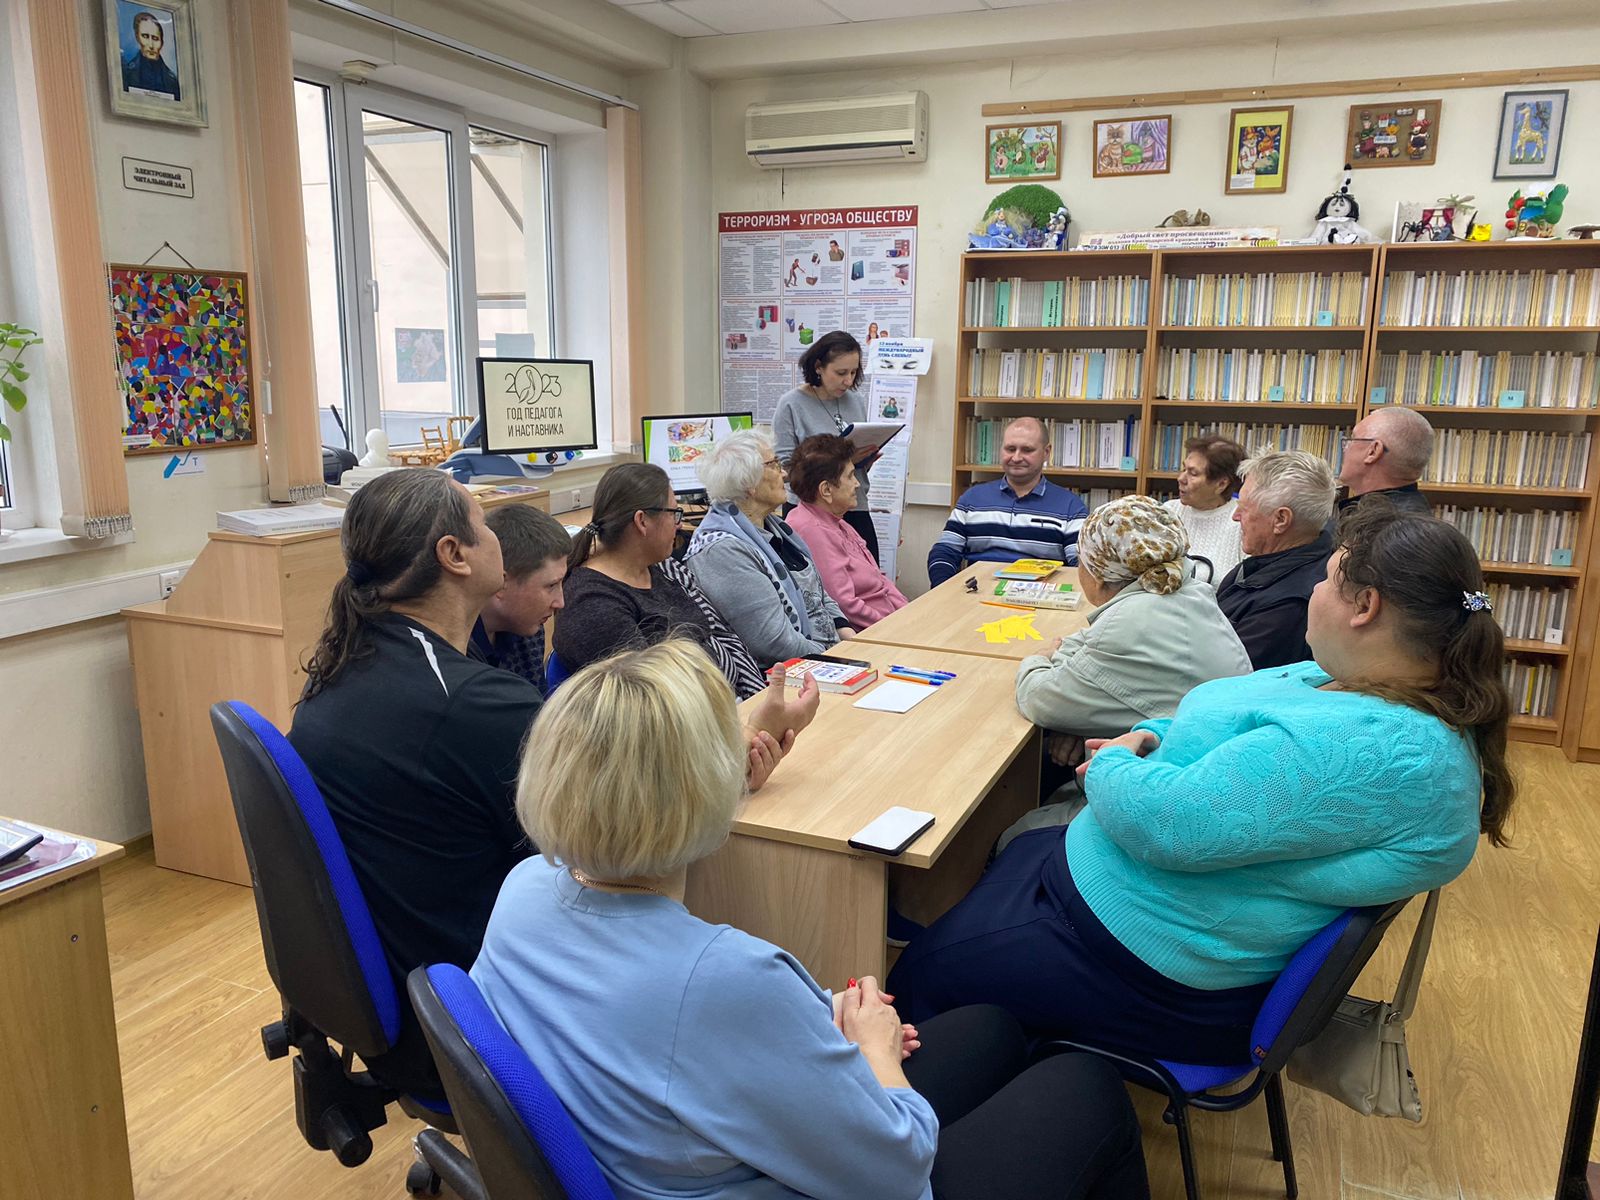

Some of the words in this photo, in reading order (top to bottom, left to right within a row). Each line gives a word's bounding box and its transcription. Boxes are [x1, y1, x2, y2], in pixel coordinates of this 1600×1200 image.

[133, 175, 173, 187] ЧИТАЛЬНЫЙ
[134, 167, 182, 181] ЭЛЕКТРОННЫЙ
[723, 214, 790, 228] ТЕРРОРИЗМ
[800, 212, 844, 225] УГРОЗА
[846, 209, 913, 224] ОБЩЕСТВУ
[506, 407, 523, 421] ГОД
[524, 406, 563, 421] ПЕДАГОГА
[507, 425, 514, 437] И
[515, 423, 564, 437] НАСТАВНИКА
